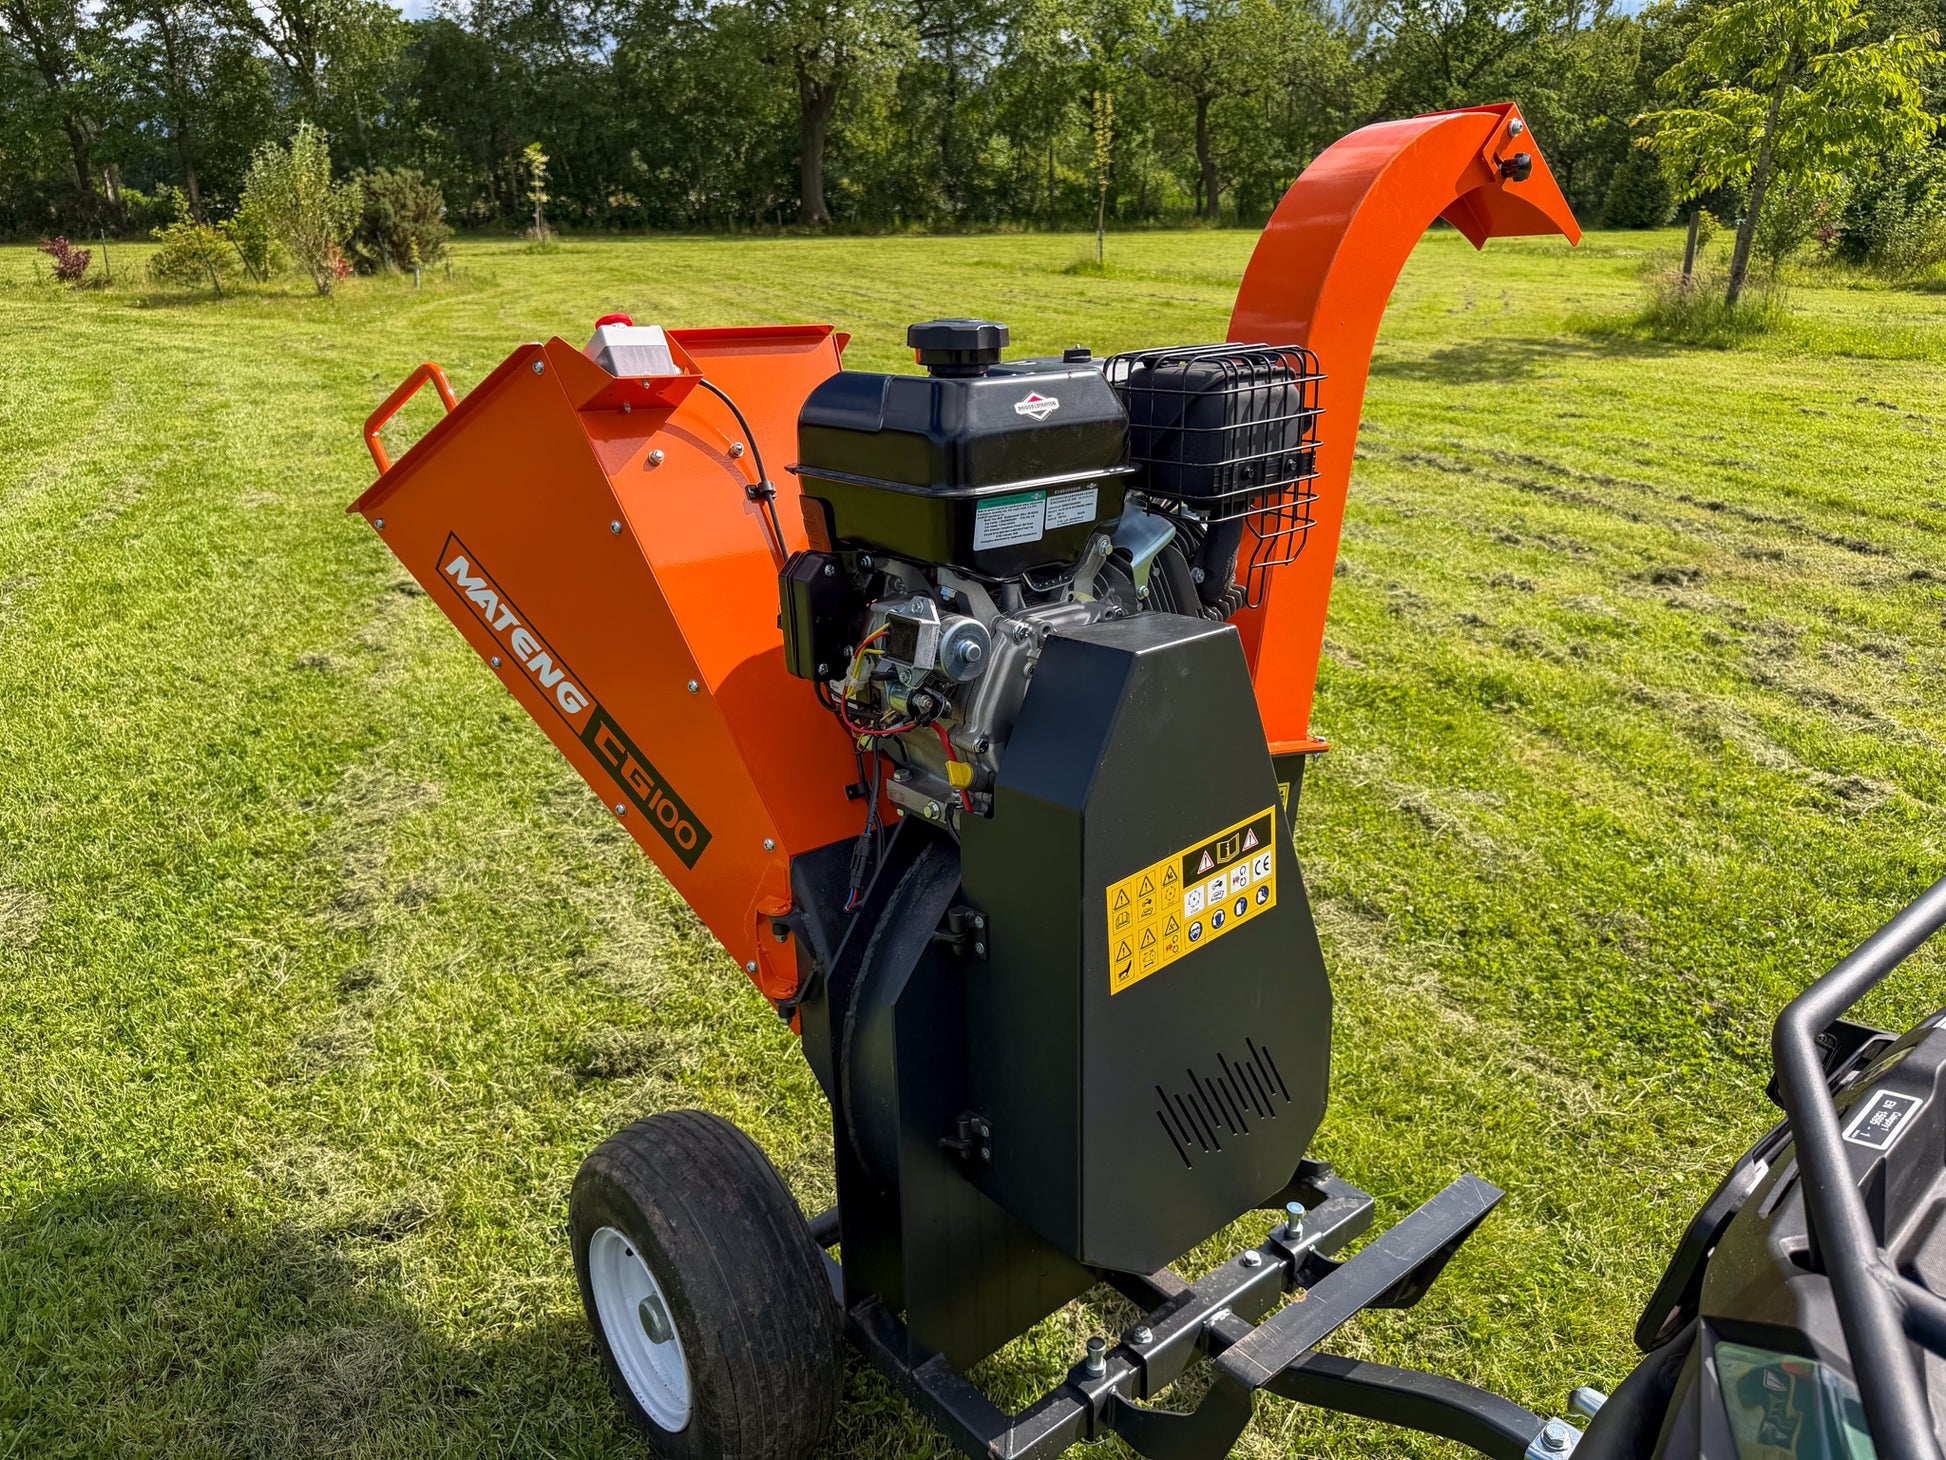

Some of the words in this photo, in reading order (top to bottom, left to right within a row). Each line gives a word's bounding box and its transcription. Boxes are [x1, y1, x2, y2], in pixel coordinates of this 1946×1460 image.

[445, 555, 590, 714] MATENG
[594, 719, 697, 850] CG100
[1254, 856, 1270, 875] CE
